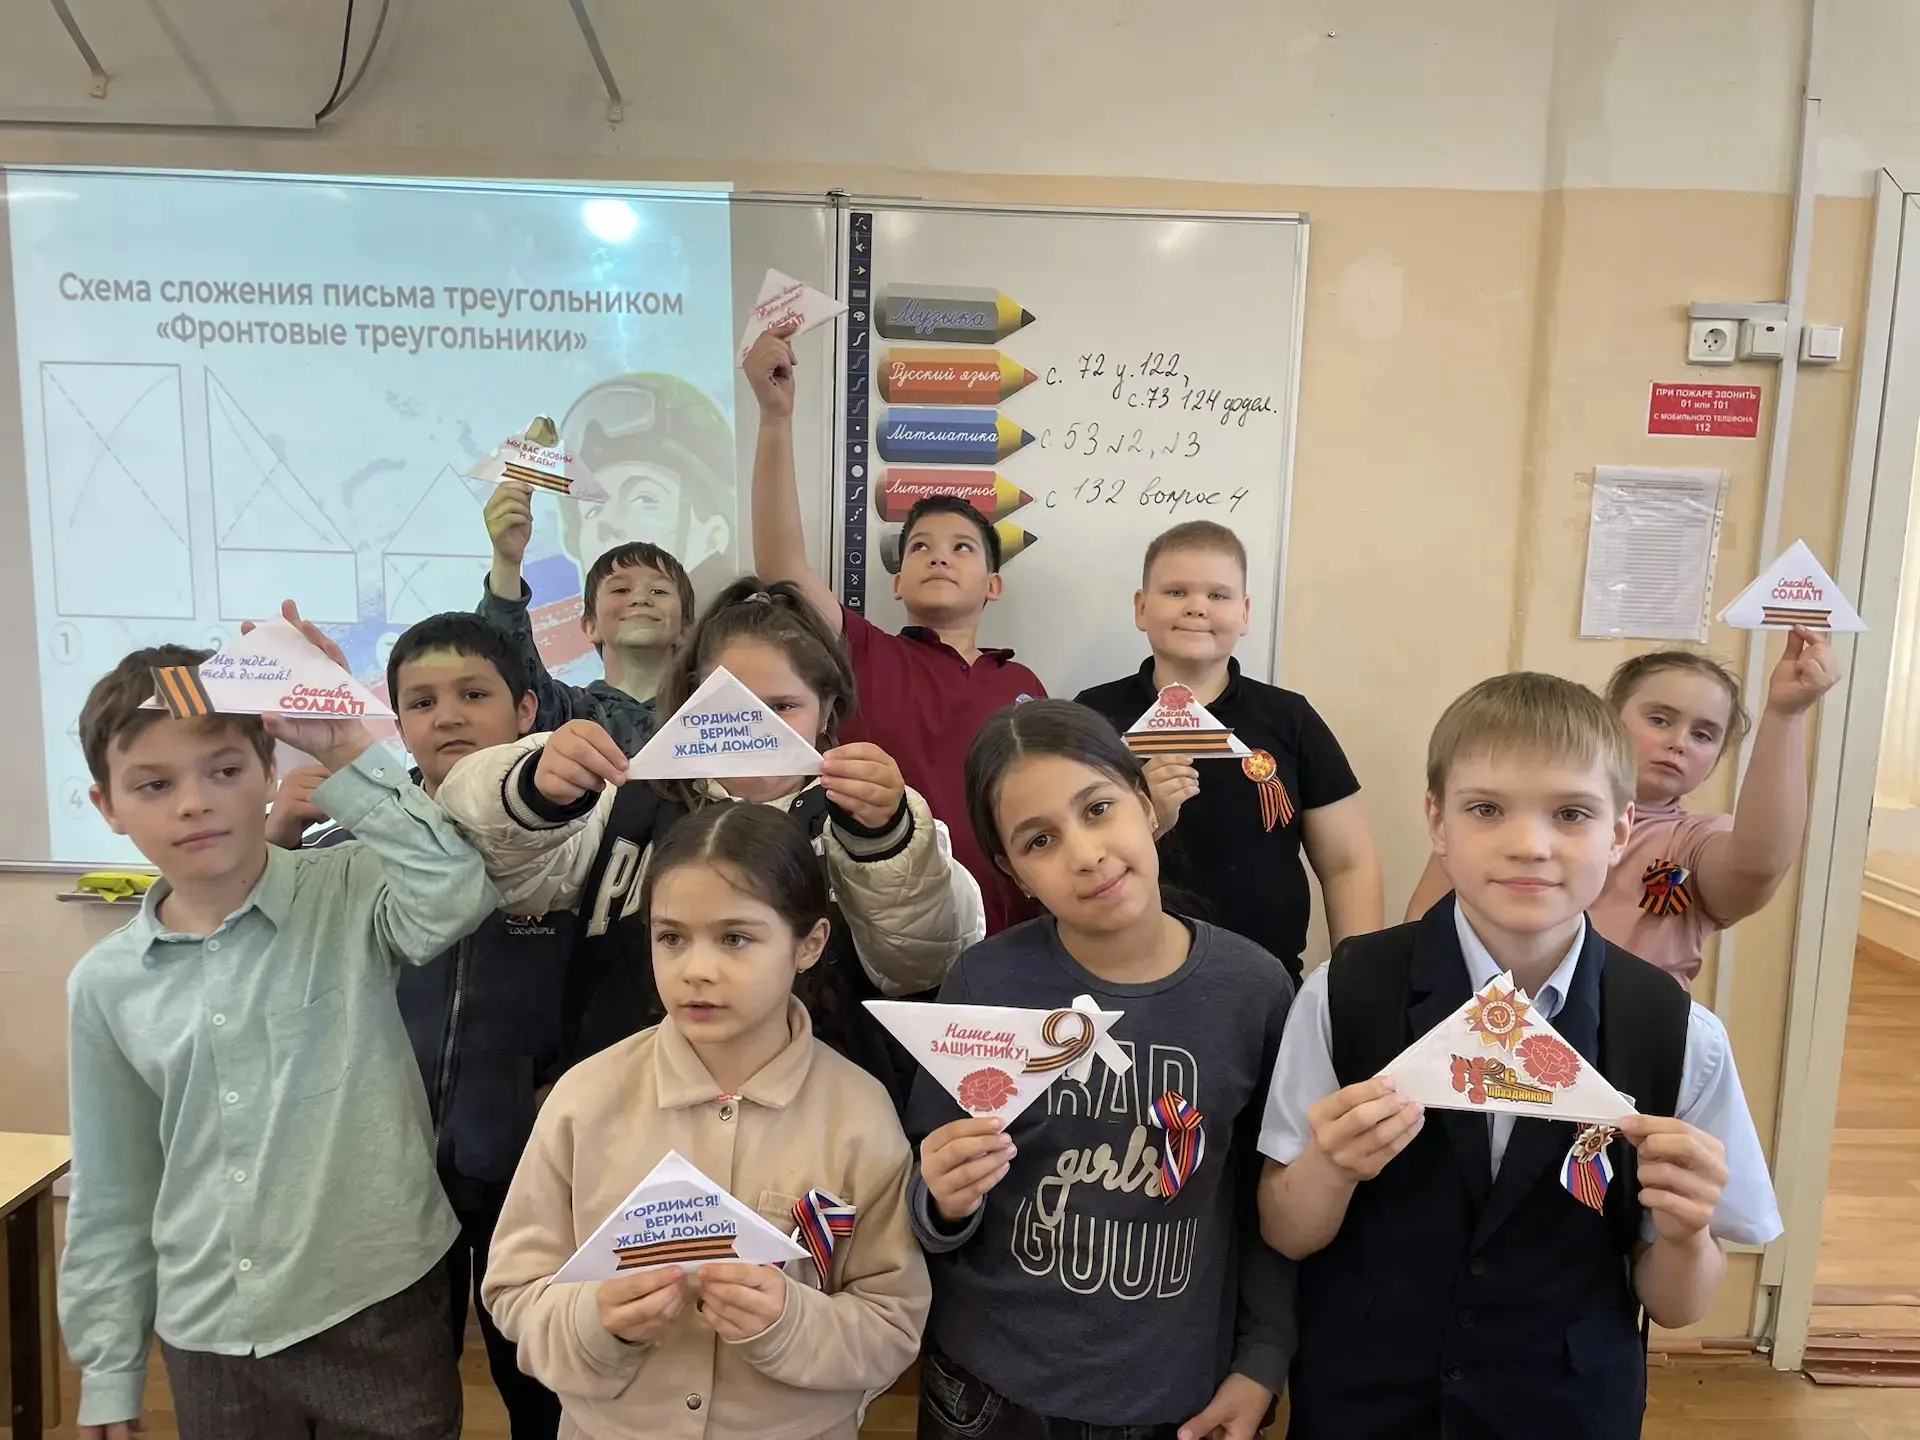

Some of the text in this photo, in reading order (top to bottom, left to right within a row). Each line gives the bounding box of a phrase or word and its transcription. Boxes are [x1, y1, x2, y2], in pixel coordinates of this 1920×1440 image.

[58, 271, 684, 319] Схема сложения письма треугольником
[890, 298, 988, 335] Музыка
[156, 312, 588, 355] «Фронтовые треугольники»
[889, 361, 1002, 388] Русский язык
[1078, 353, 1106, 379] 72
[1181, 388, 1221, 412] 124
[1655, 388, 1757, 400] ПРИ ПОЖАРЕ ЗВОНИТЬ
[1680, 399, 1692, 408] 01
[1713, 400, 1729, 409] 101
[1660, 413, 1712, 421] МОБИЛЬНОГО
[1713, 415, 1753, 423] ТЕЛЕФОНА
[1695, 423, 1711, 432] 112
[886, 424, 999, 443] Математика
[1064, 422, 1100, 456] 53
[506, 439, 521, 449] МЫ
[522, 444, 540, 454] ВАС
[885, 479, 997, 499] Литературное
[1074, 477, 1126, 505] 132
[1139, 476, 1221, 514] вопрос
[1778, 576, 1815, 591] Спасибо,
[60, 633, 70, 655] 1
[209, 653, 235, 666] Мы
[200, 665, 292, 681] тебя домой!
[292, 683, 354, 700] Спасибо,
[682, 710, 763, 727] ГОРДИМСЯ!
[700, 726, 750, 740] ВЕРИМ!
[674, 734, 779, 757] ЖДЁМ ДОМОЙ!
[945, 1023, 1016, 1049] Нашему
[930, 1040, 1030, 1061] ЗАЩИТНИКУ!
[1037, 1124, 1163, 1227] girls
[625, 1194, 720, 1221] ГОРДИМСЯ!
[645, 1211, 703, 1229] ВЕРИМ!
[616, 1219, 736, 1248] ЖДЁМ ДОМОЙ!
